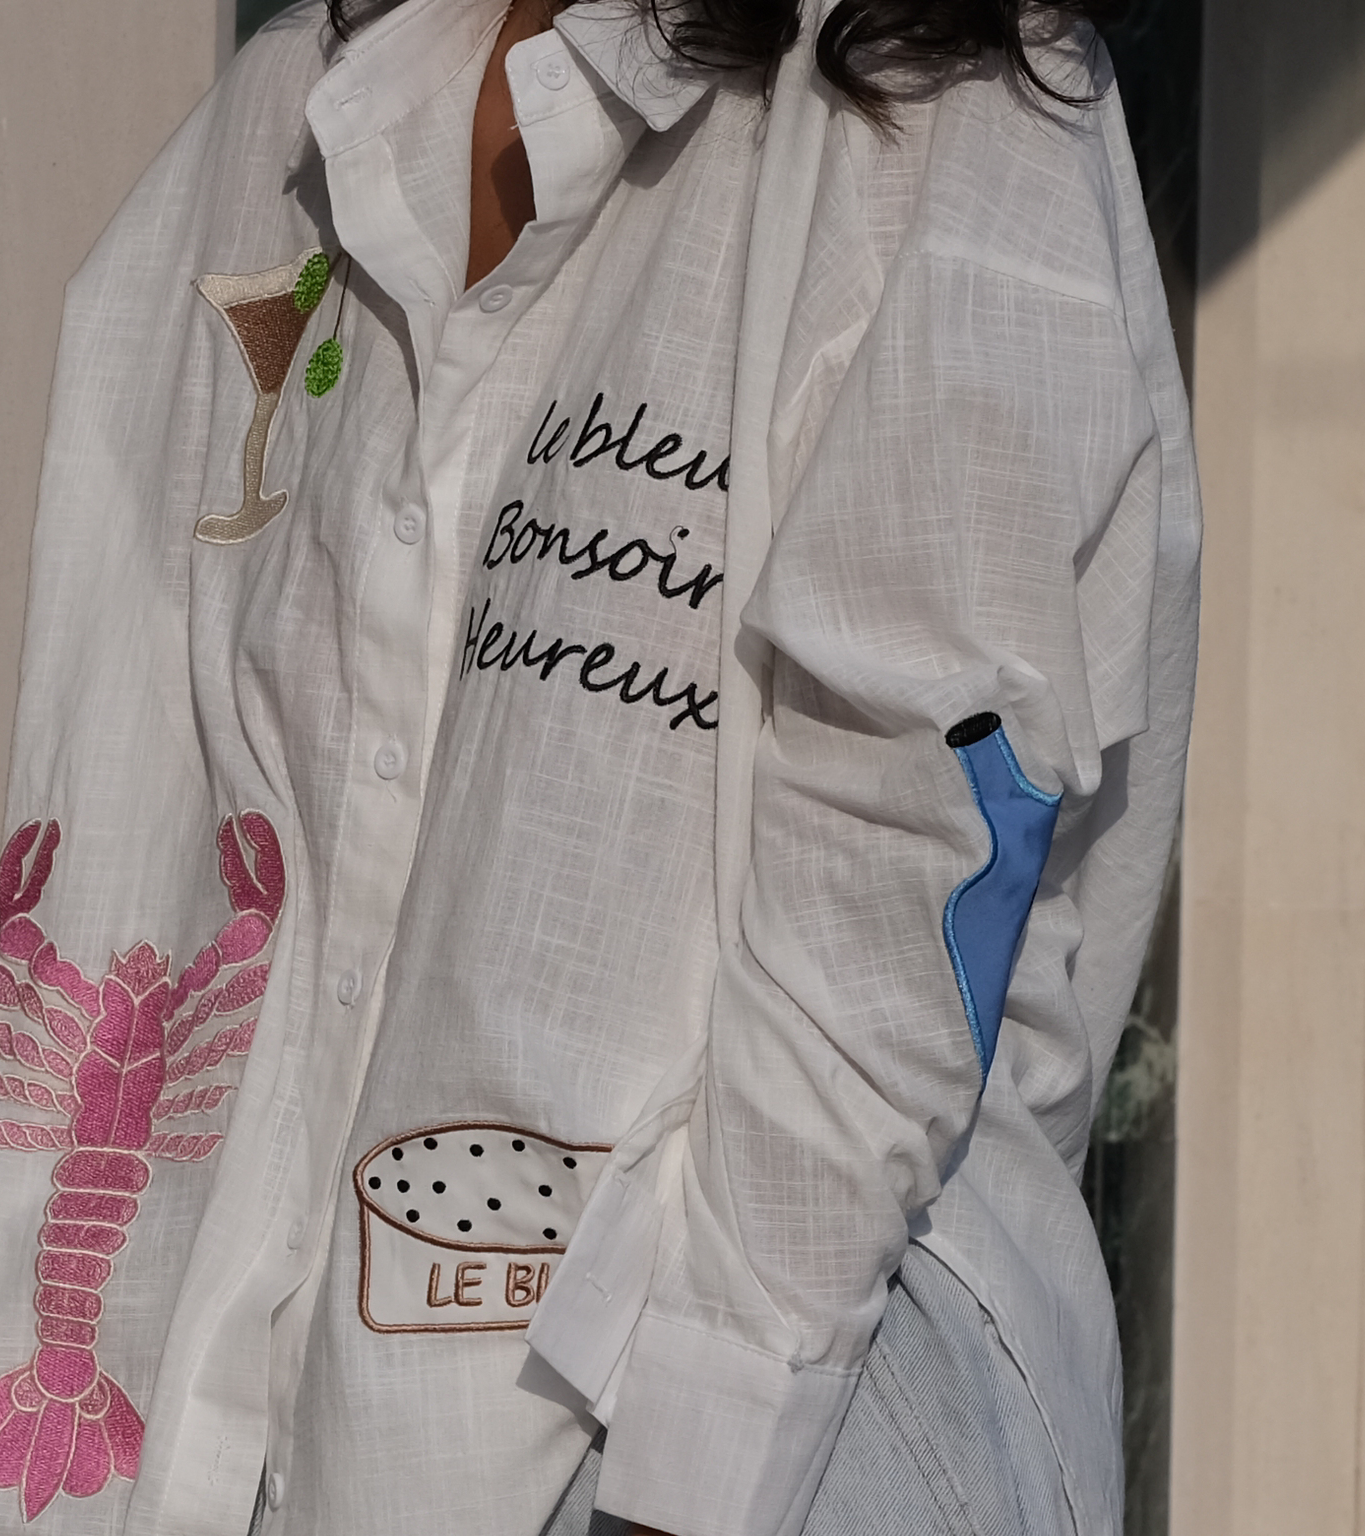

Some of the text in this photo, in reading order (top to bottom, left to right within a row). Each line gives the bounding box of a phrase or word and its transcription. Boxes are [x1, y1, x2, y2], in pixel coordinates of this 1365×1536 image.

[482, 500, 725, 610] Bonsoir
[459, 597, 720, 731] Heureux
[426, 1261, 487, 1308] LE
